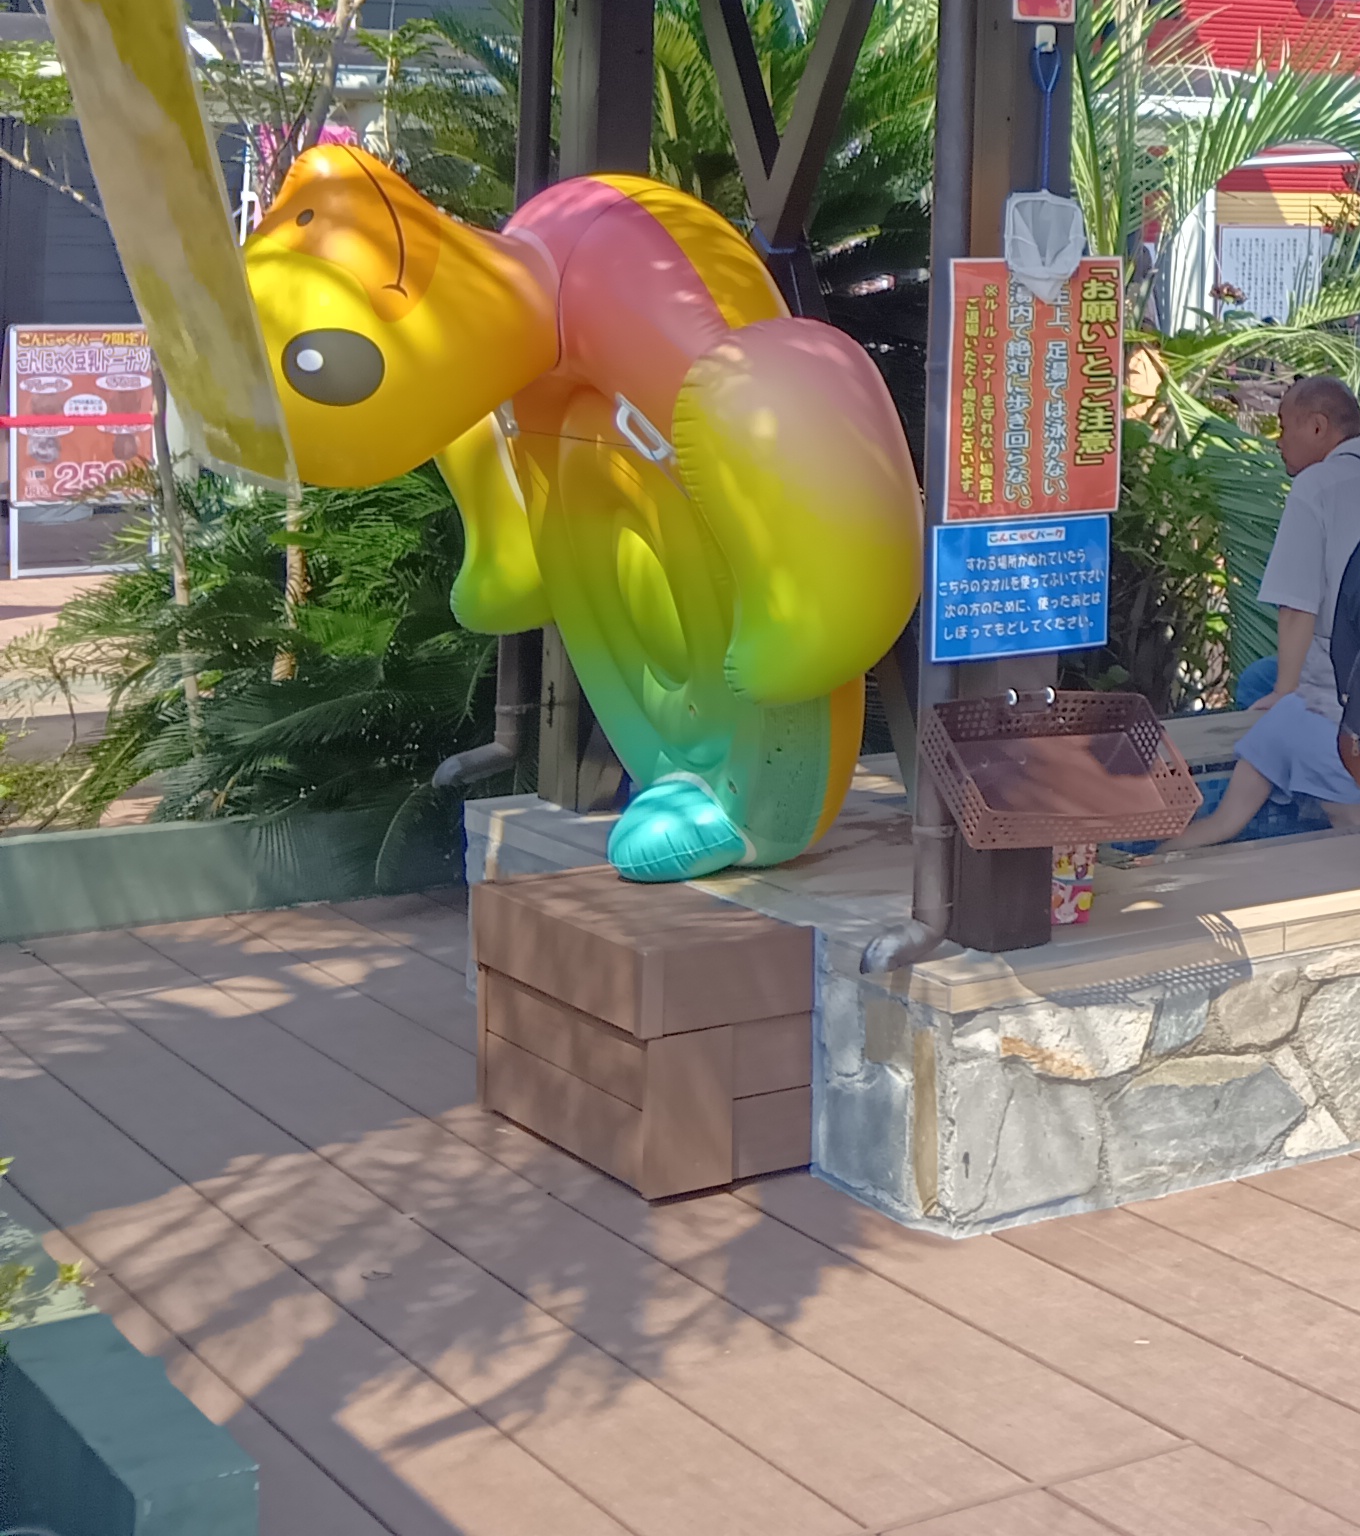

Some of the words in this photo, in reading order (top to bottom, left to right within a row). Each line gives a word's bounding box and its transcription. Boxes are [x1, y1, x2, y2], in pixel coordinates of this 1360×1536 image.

[1004, 270, 1033, 509] 湯内で絶対に歩き回らない。
[1042, 276, 1070, 504] 生上、足湯では泳がない、
[988, 528, 1065, 544] こんにゃくパーク
